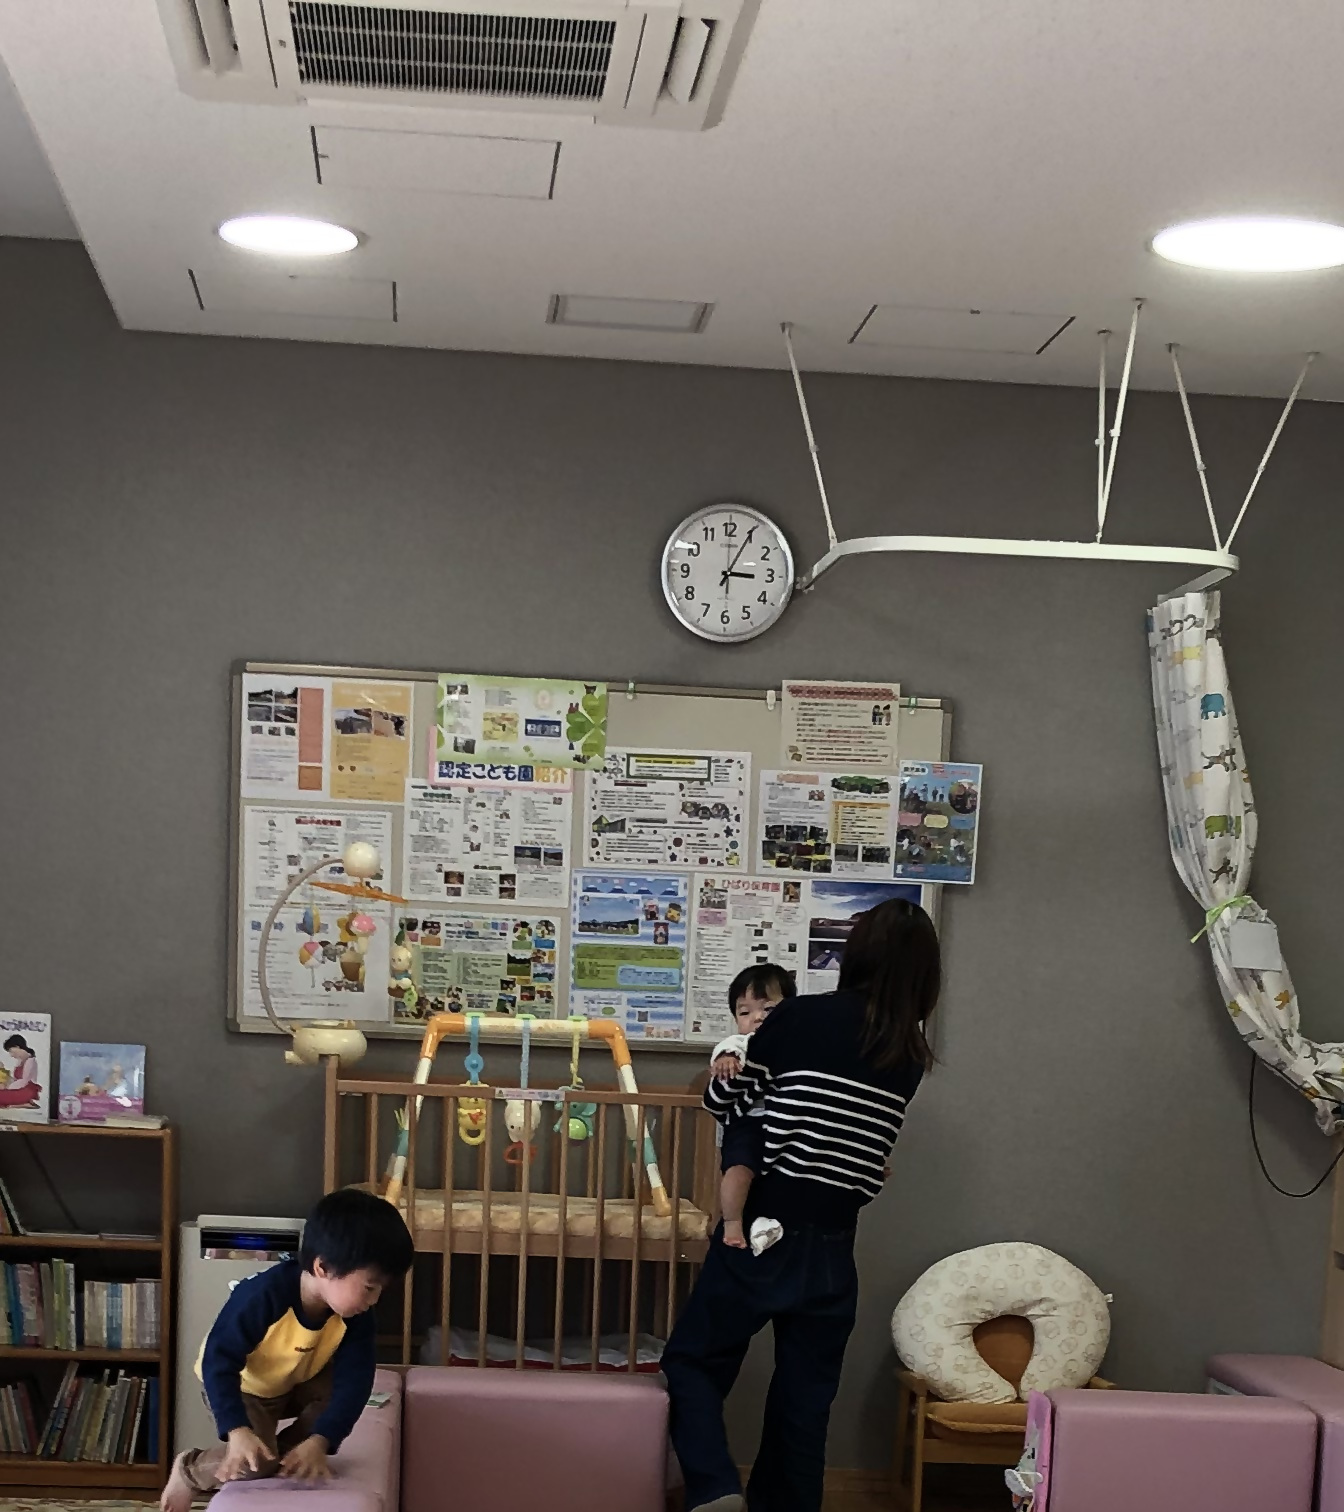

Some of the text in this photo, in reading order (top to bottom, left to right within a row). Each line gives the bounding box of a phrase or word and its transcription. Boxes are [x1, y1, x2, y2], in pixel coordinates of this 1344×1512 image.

[703, 527, 715, 541] 11
[722, 522, 737, 537] 12
[761, 546, 771, 561] 2
[680, 563, 690, 578] 9
[765, 568, 775, 583] 3
[684, 585, 695, 600] 8
[757, 590, 767, 605] 4
[701, 603, 711, 617] 7
[720, 610, 730, 624] 6
[741, 605, 751, 620] 5
